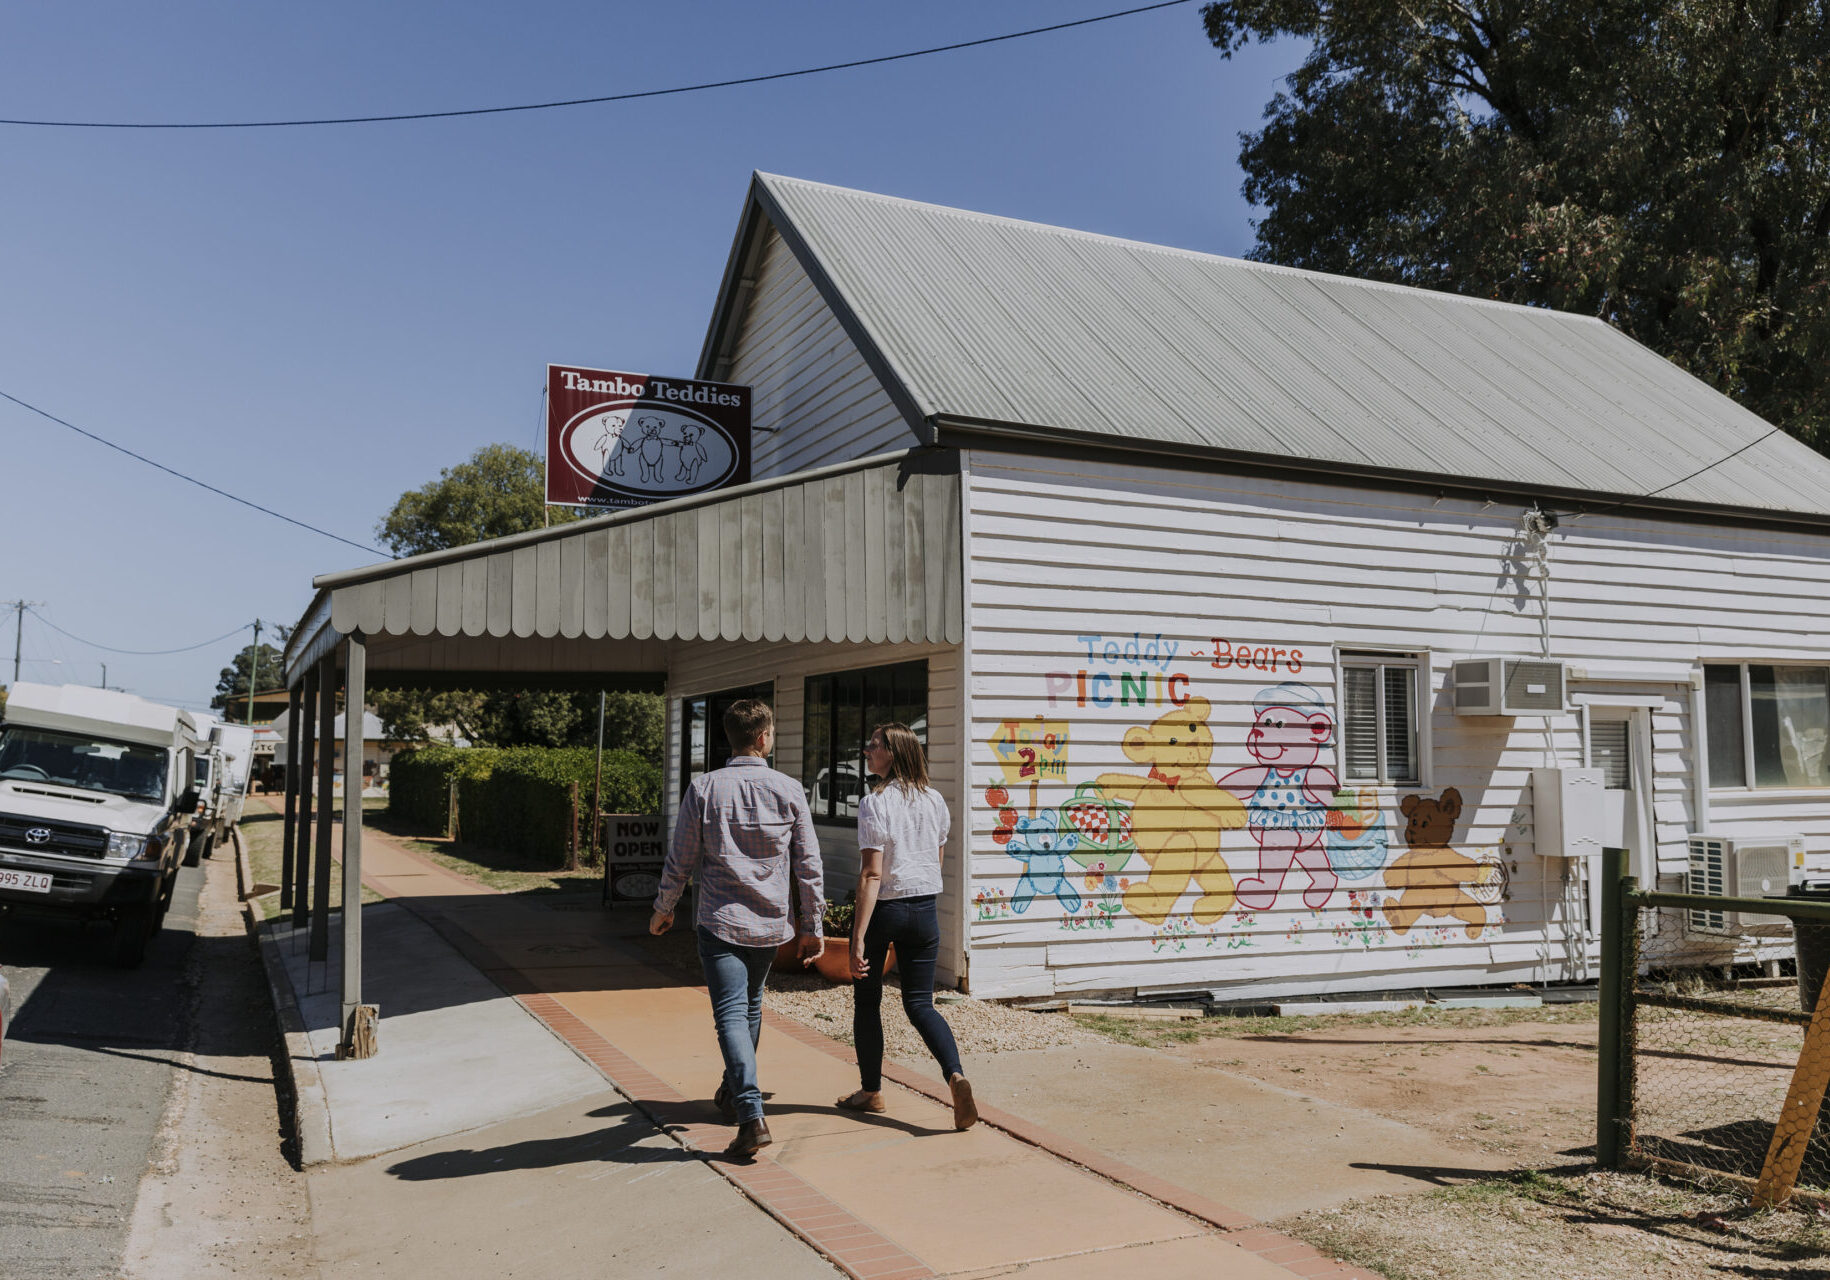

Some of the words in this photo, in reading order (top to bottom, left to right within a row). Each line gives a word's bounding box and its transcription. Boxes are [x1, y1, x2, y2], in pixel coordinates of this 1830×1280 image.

[561, 371, 645, 396] Tambo
[651, 380, 741, 407] Teddies
[1077, 632, 1179, 672] Teddy
[1210, 637, 1304, 674] Bears
[1044, 669, 1191, 708] PICNIC
[1004, 721, 1067, 756] Today
[1018, 747, 1036, 777] 2
[617, 822, 659, 837] NOW
[614, 842, 662, 856] OPEN
